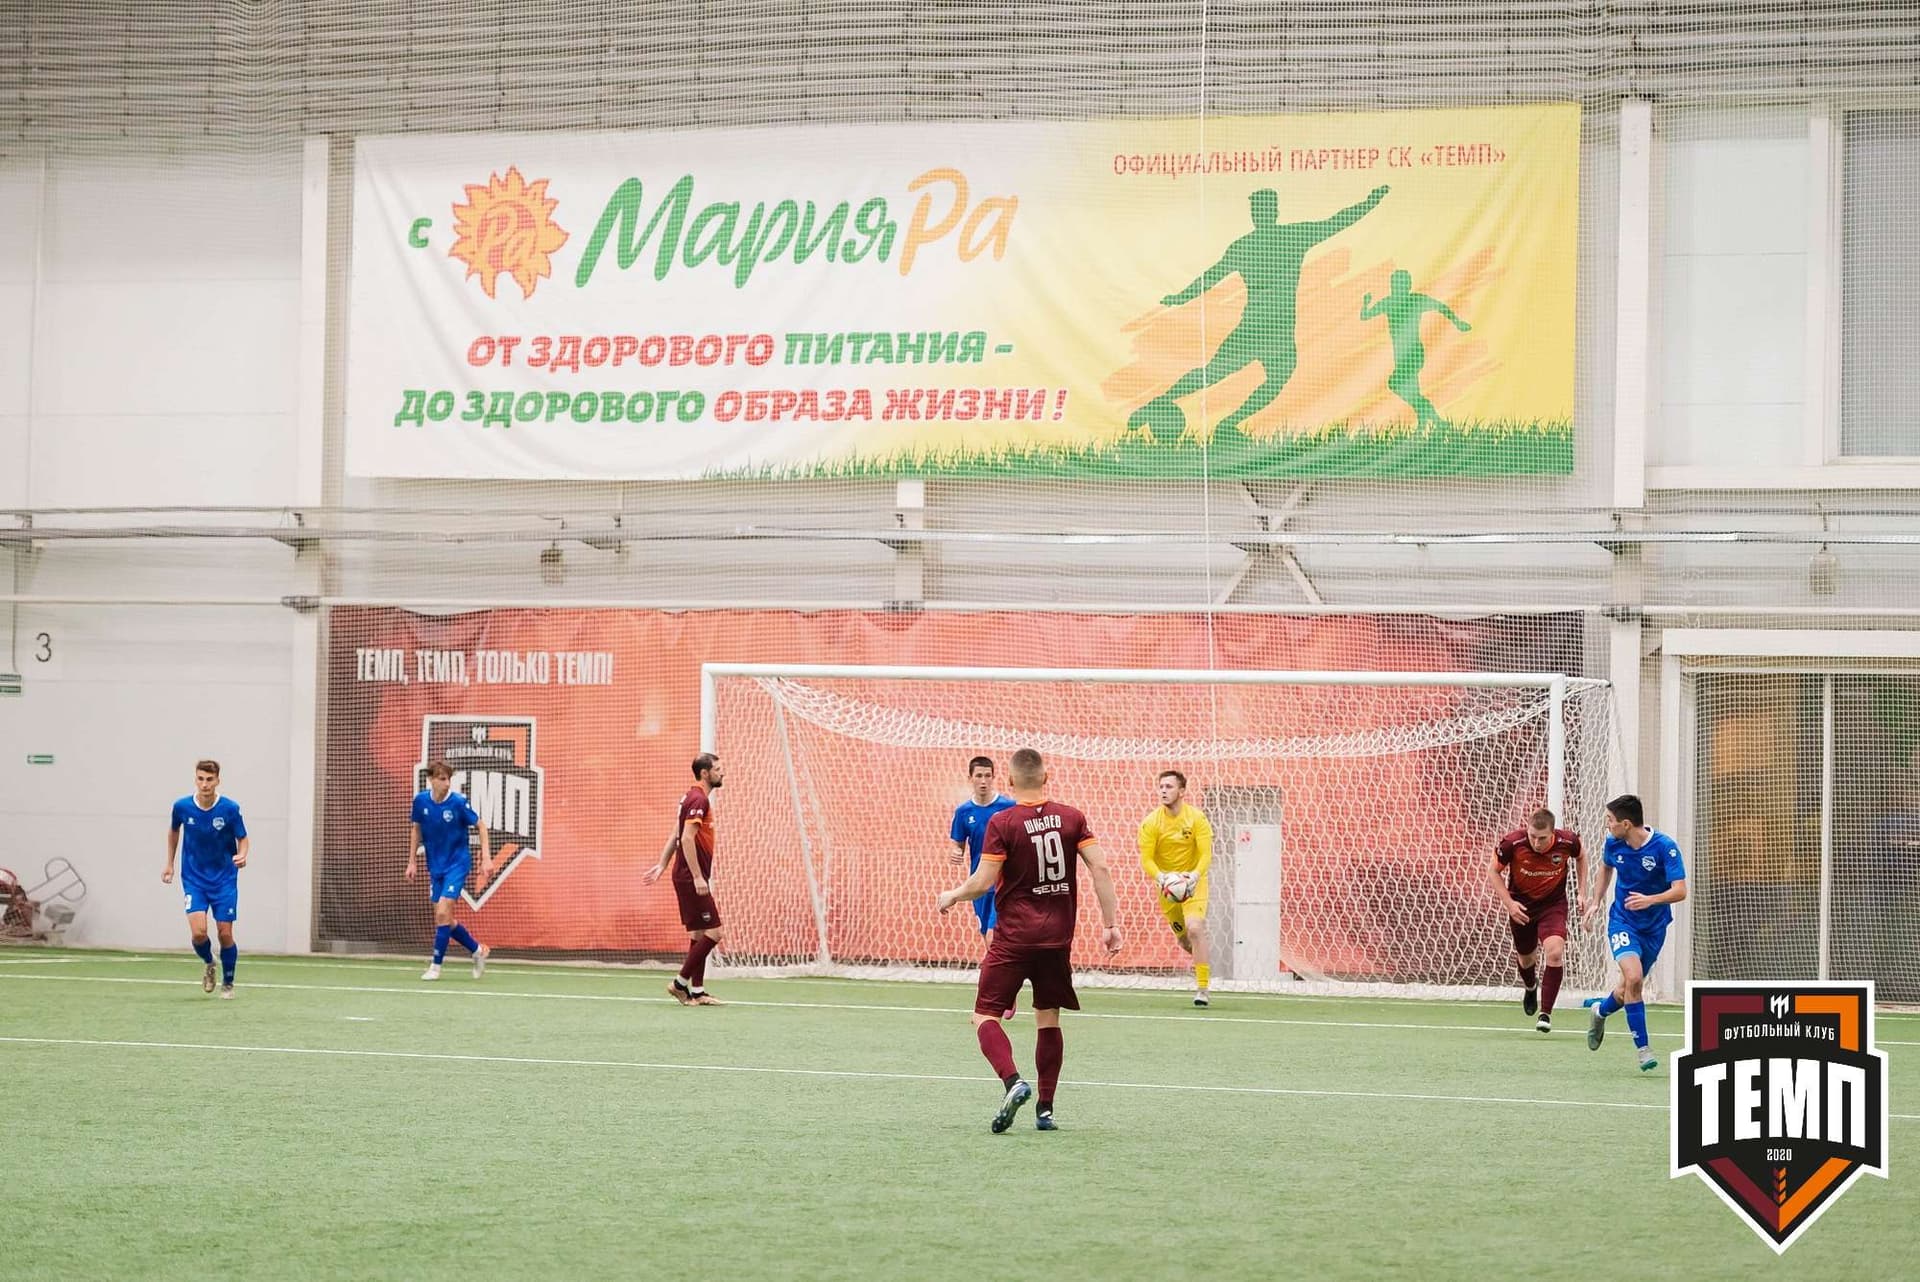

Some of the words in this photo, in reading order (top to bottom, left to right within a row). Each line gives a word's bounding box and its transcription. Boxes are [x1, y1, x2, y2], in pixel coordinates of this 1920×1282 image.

[1113, 146, 1283, 179] ОФИЦИАЛЬНЫЙ
[1289, 147, 1380, 173] ПАРТНЕР
[1387, 146, 1412, 169] СК
[1419, 143, 1507, 167] «ТЕМП»
[468, 337, 521, 366] ОТ
[529, 335, 774, 373] ЗДОРОВОГО
[785, 332, 986, 365] ПИТАНИЯ
[395, 391, 454, 427] ДО
[461, 391, 705, 428] ЗДОРОВОГО
[714, 390, 873, 422] ОБРАЗА
[35, 632, 52, 662] 3
[357, 648, 408, 685] ТЕМП,
[416, 650, 470, 687] ТЕМП,
[476, 651, 549, 684] ТОЛЬКО
[555, 652, 614, 685] ТЕМП!
[1031, 830, 1066, 883] 19
[1032, 882, 1070, 895] SEUS
[1611, 931, 1630, 952] 28
